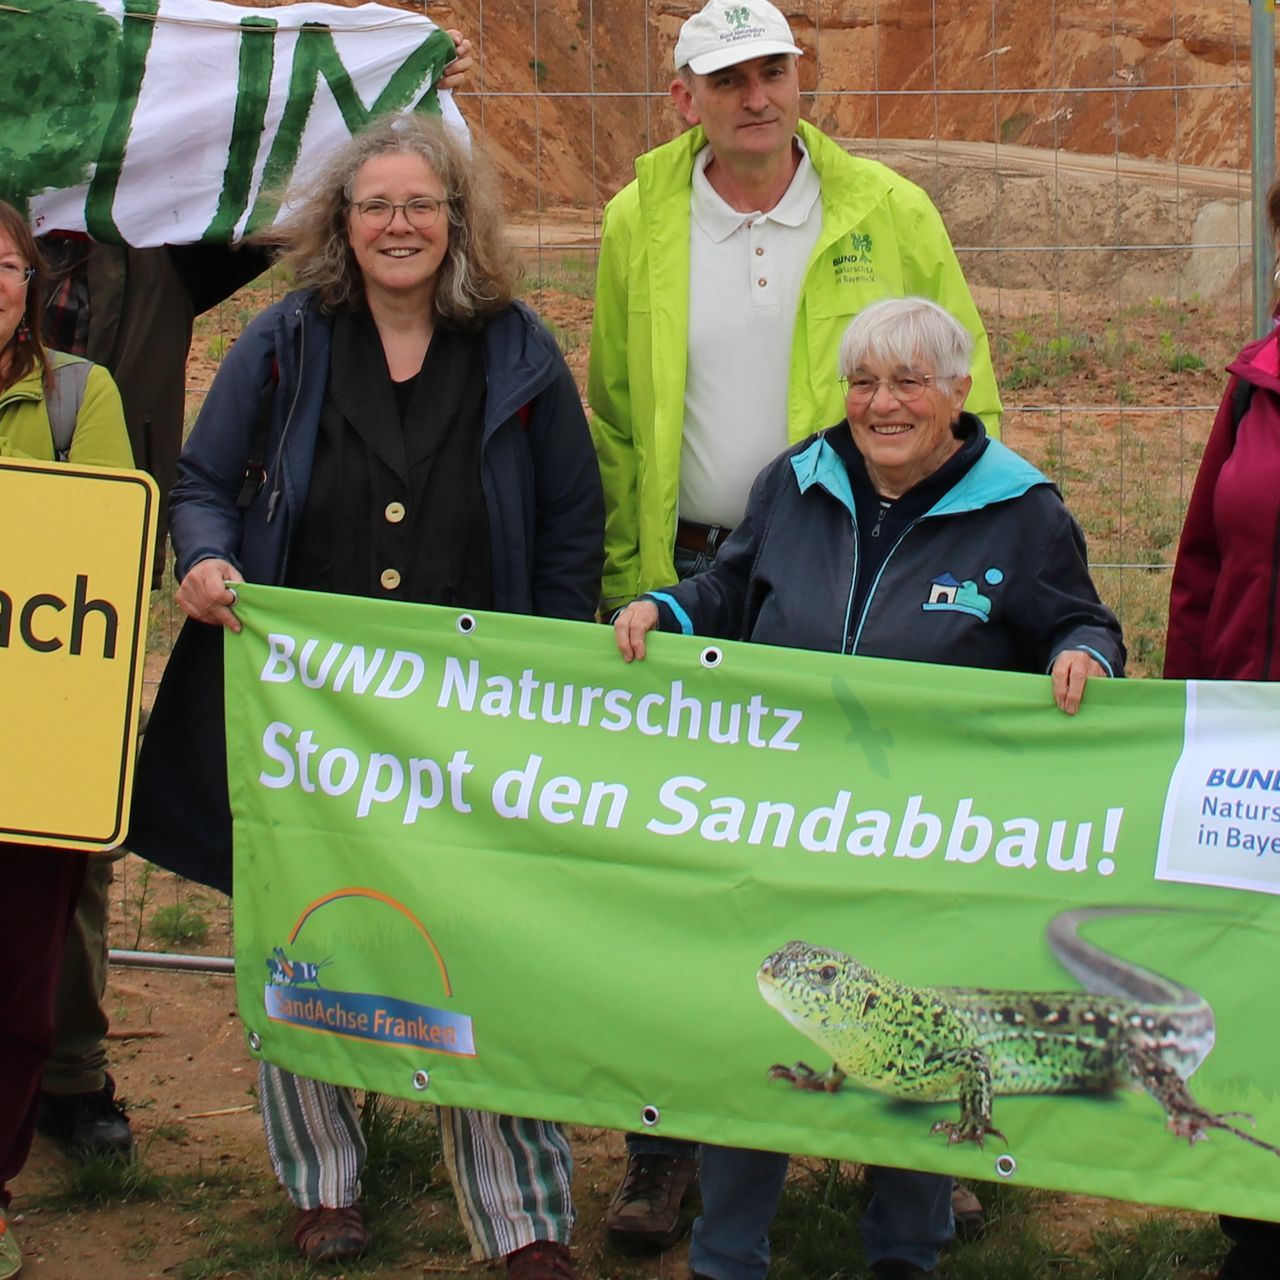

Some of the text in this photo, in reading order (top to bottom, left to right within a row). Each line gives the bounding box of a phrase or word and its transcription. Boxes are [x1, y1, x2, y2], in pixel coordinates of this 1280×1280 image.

[832, 255, 858, 267] BUND
[260, 633, 803, 751] BUND Naturschutz
[259, 721, 1125, 877] Stoppt den Sandabbau!
[1197, 824, 1219, 846] in
[274, 990, 456, 1045] SandAchse Franken
